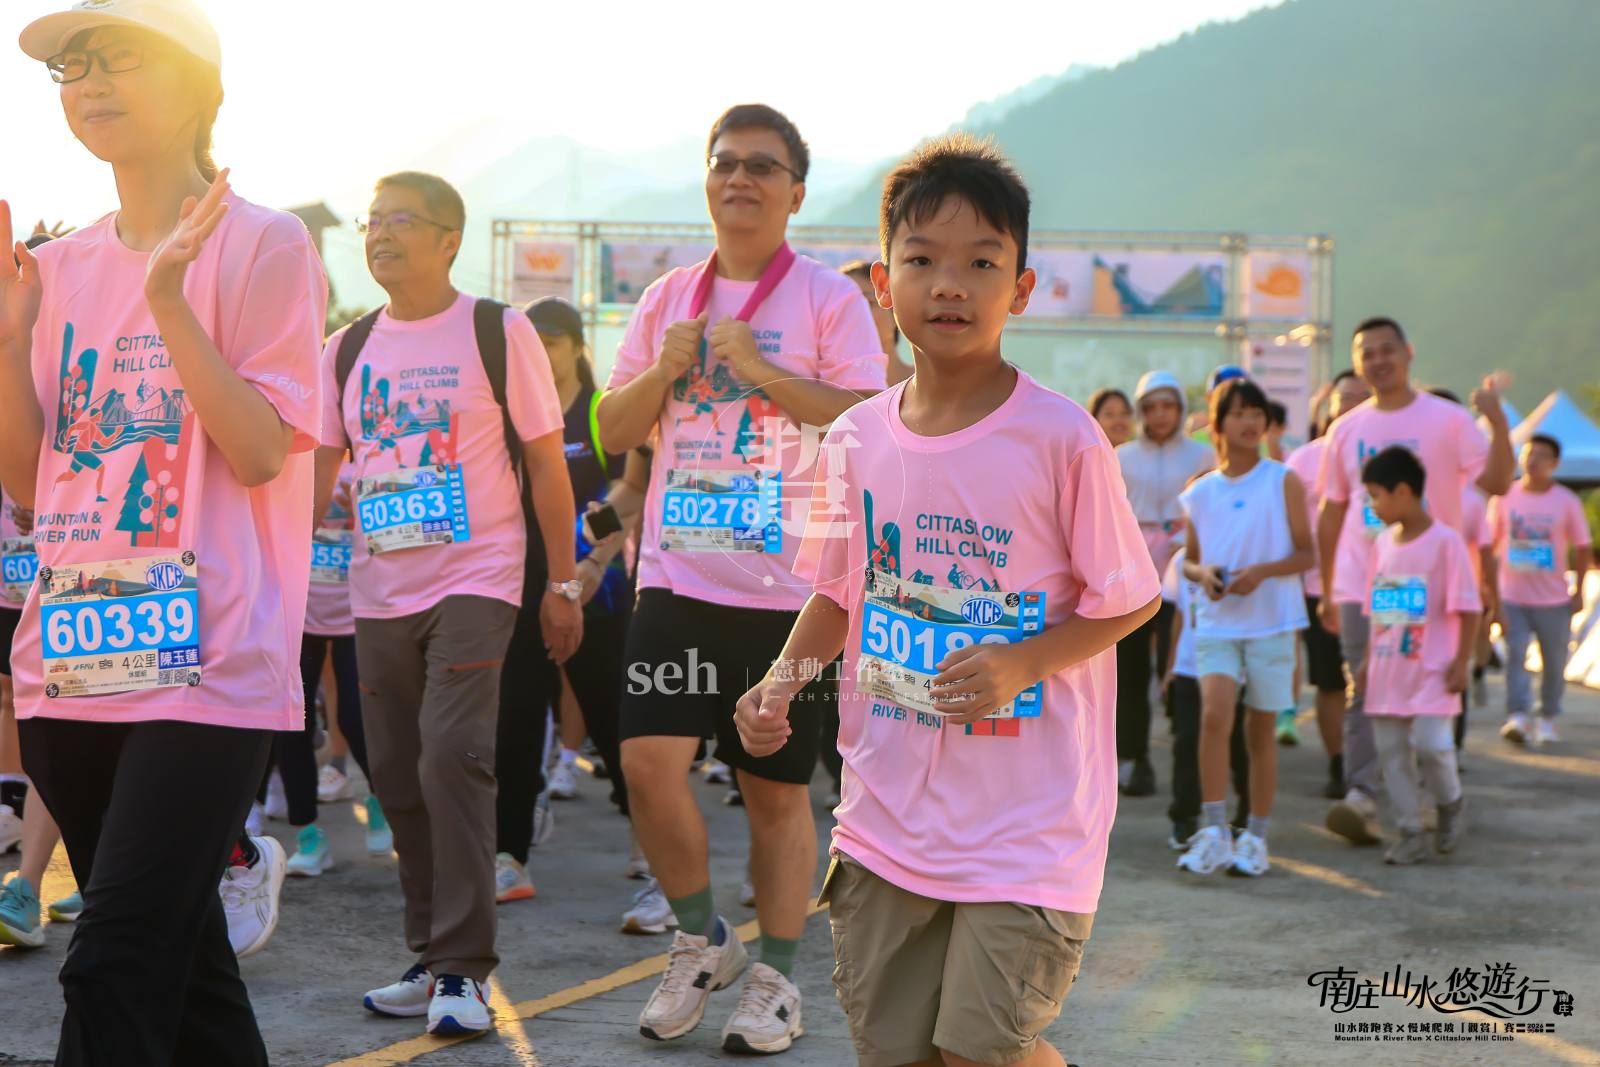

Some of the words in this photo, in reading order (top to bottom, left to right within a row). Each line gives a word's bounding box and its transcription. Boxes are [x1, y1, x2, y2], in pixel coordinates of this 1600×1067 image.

[113, 357, 145, 373] HILL
[400, 366, 459, 379] CITTASLOW
[399, 381, 420, 391] HILL
[424, 378, 459, 388] CLIMB
[91, 511, 102, 524] &
[361, 490, 447, 531] 50363
[667, 496, 760, 525] 50278
[71, 528, 101, 541] RUN
[916, 513, 1013, 546] CITTASLOW
[916, 537, 955, 556] HILL
[46, 597, 193, 655] 60339
[871, 703, 907, 721] RIVER
[917, 711, 941, 729] RUN
